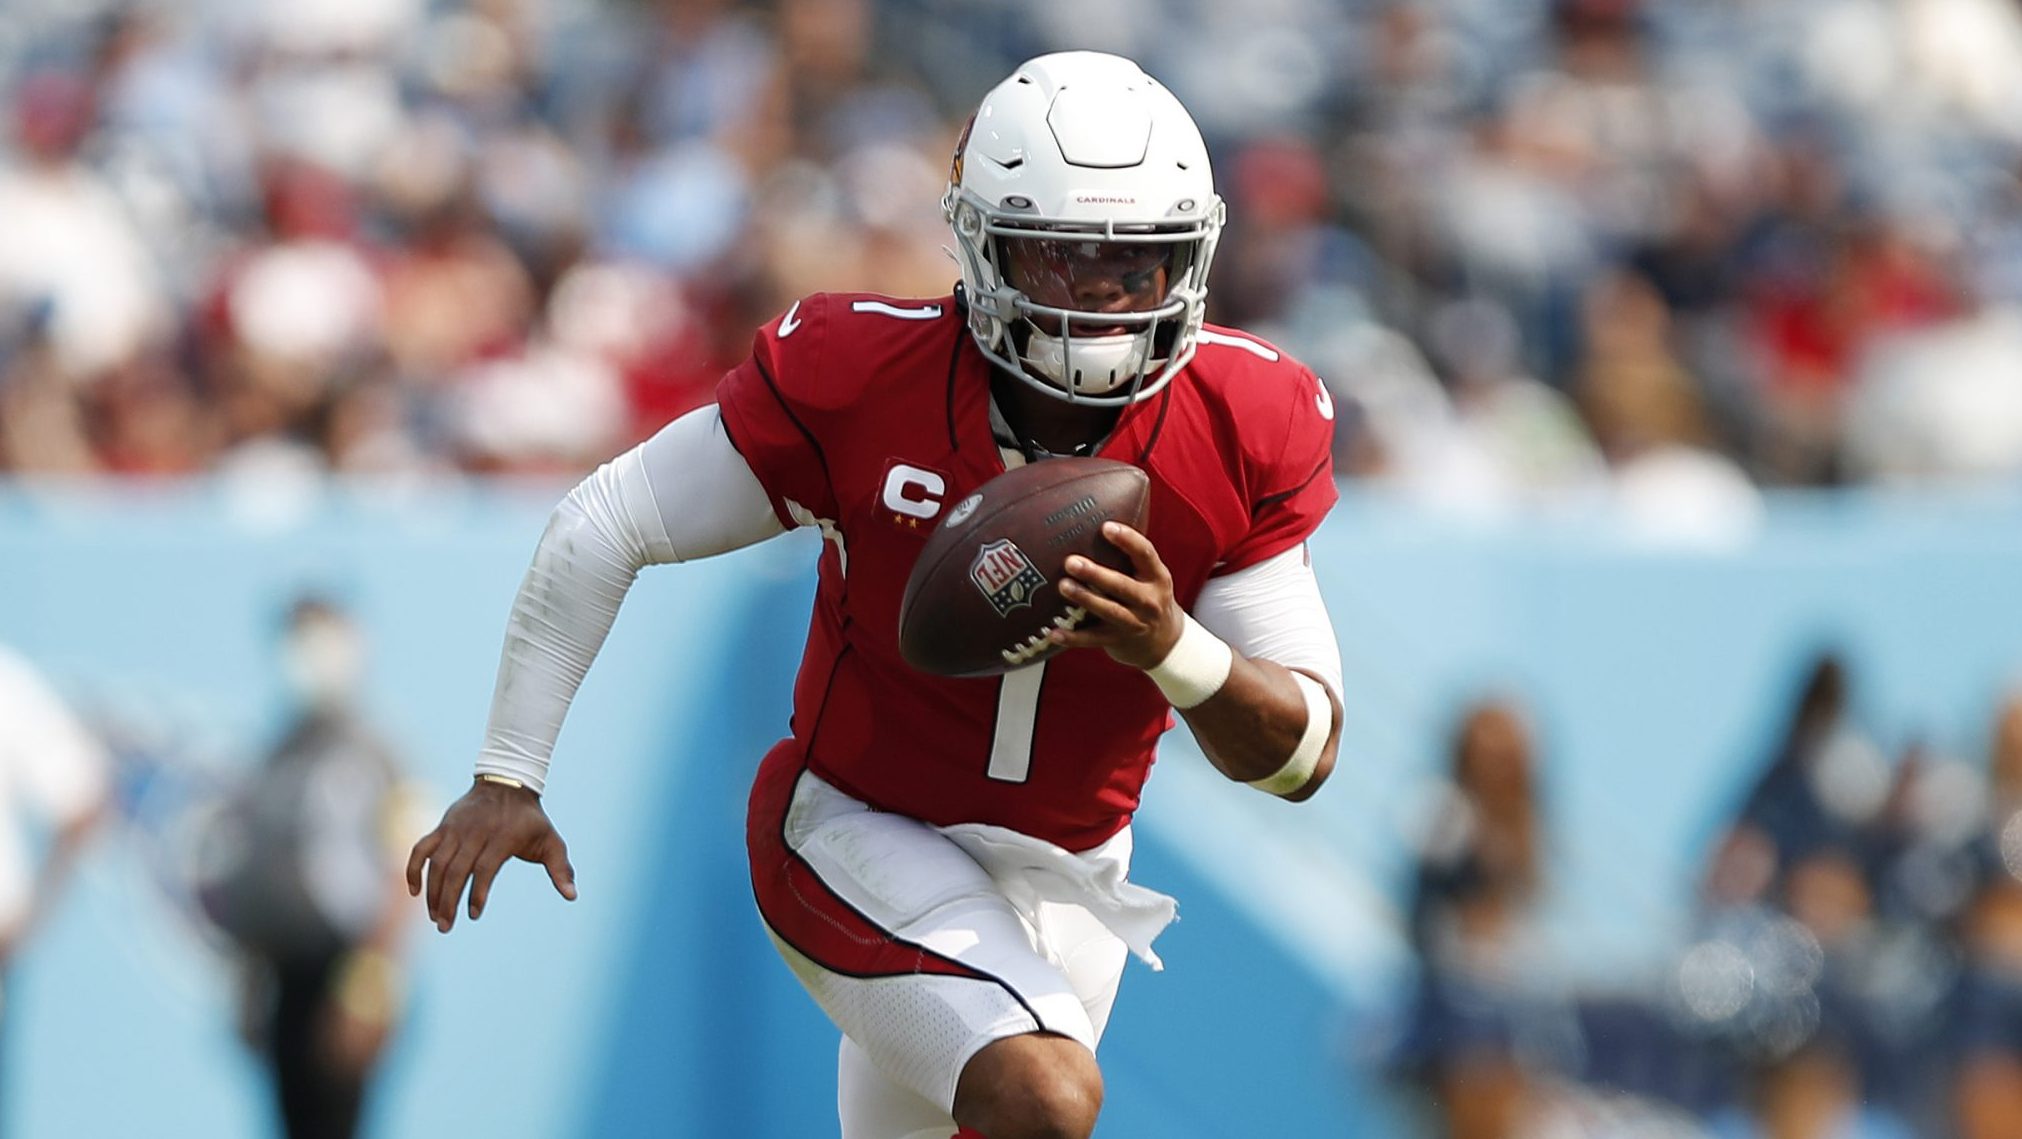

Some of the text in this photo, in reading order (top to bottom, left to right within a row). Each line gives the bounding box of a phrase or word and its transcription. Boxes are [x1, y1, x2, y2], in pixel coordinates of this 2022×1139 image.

[1076, 196, 1136, 205] CARDINALS
[883, 463, 946, 520] C
[976, 546, 1025, 590] NFL
